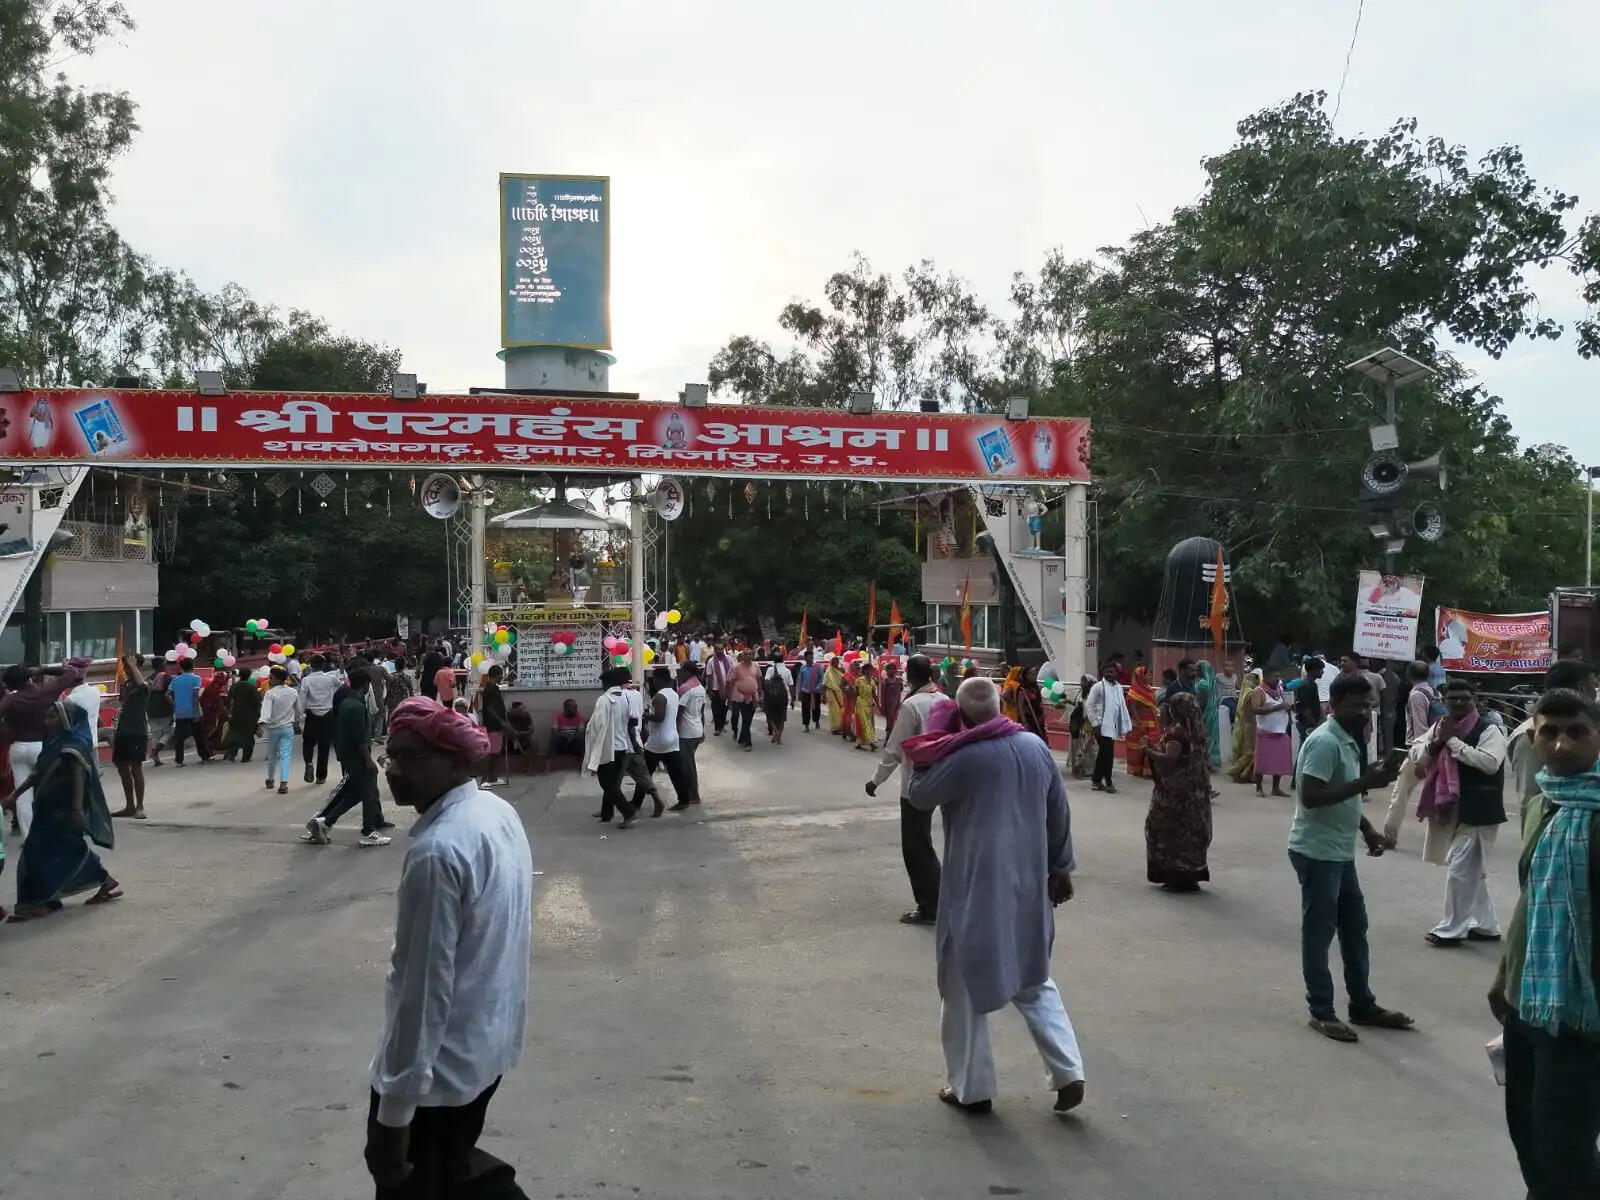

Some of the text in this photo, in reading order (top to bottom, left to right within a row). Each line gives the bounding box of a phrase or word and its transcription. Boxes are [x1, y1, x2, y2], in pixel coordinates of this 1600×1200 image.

[235, 400, 341, 434] श्री
[348, 407, 644, 441] परमहंस
[696, 422, 906, 450] आश्रम
